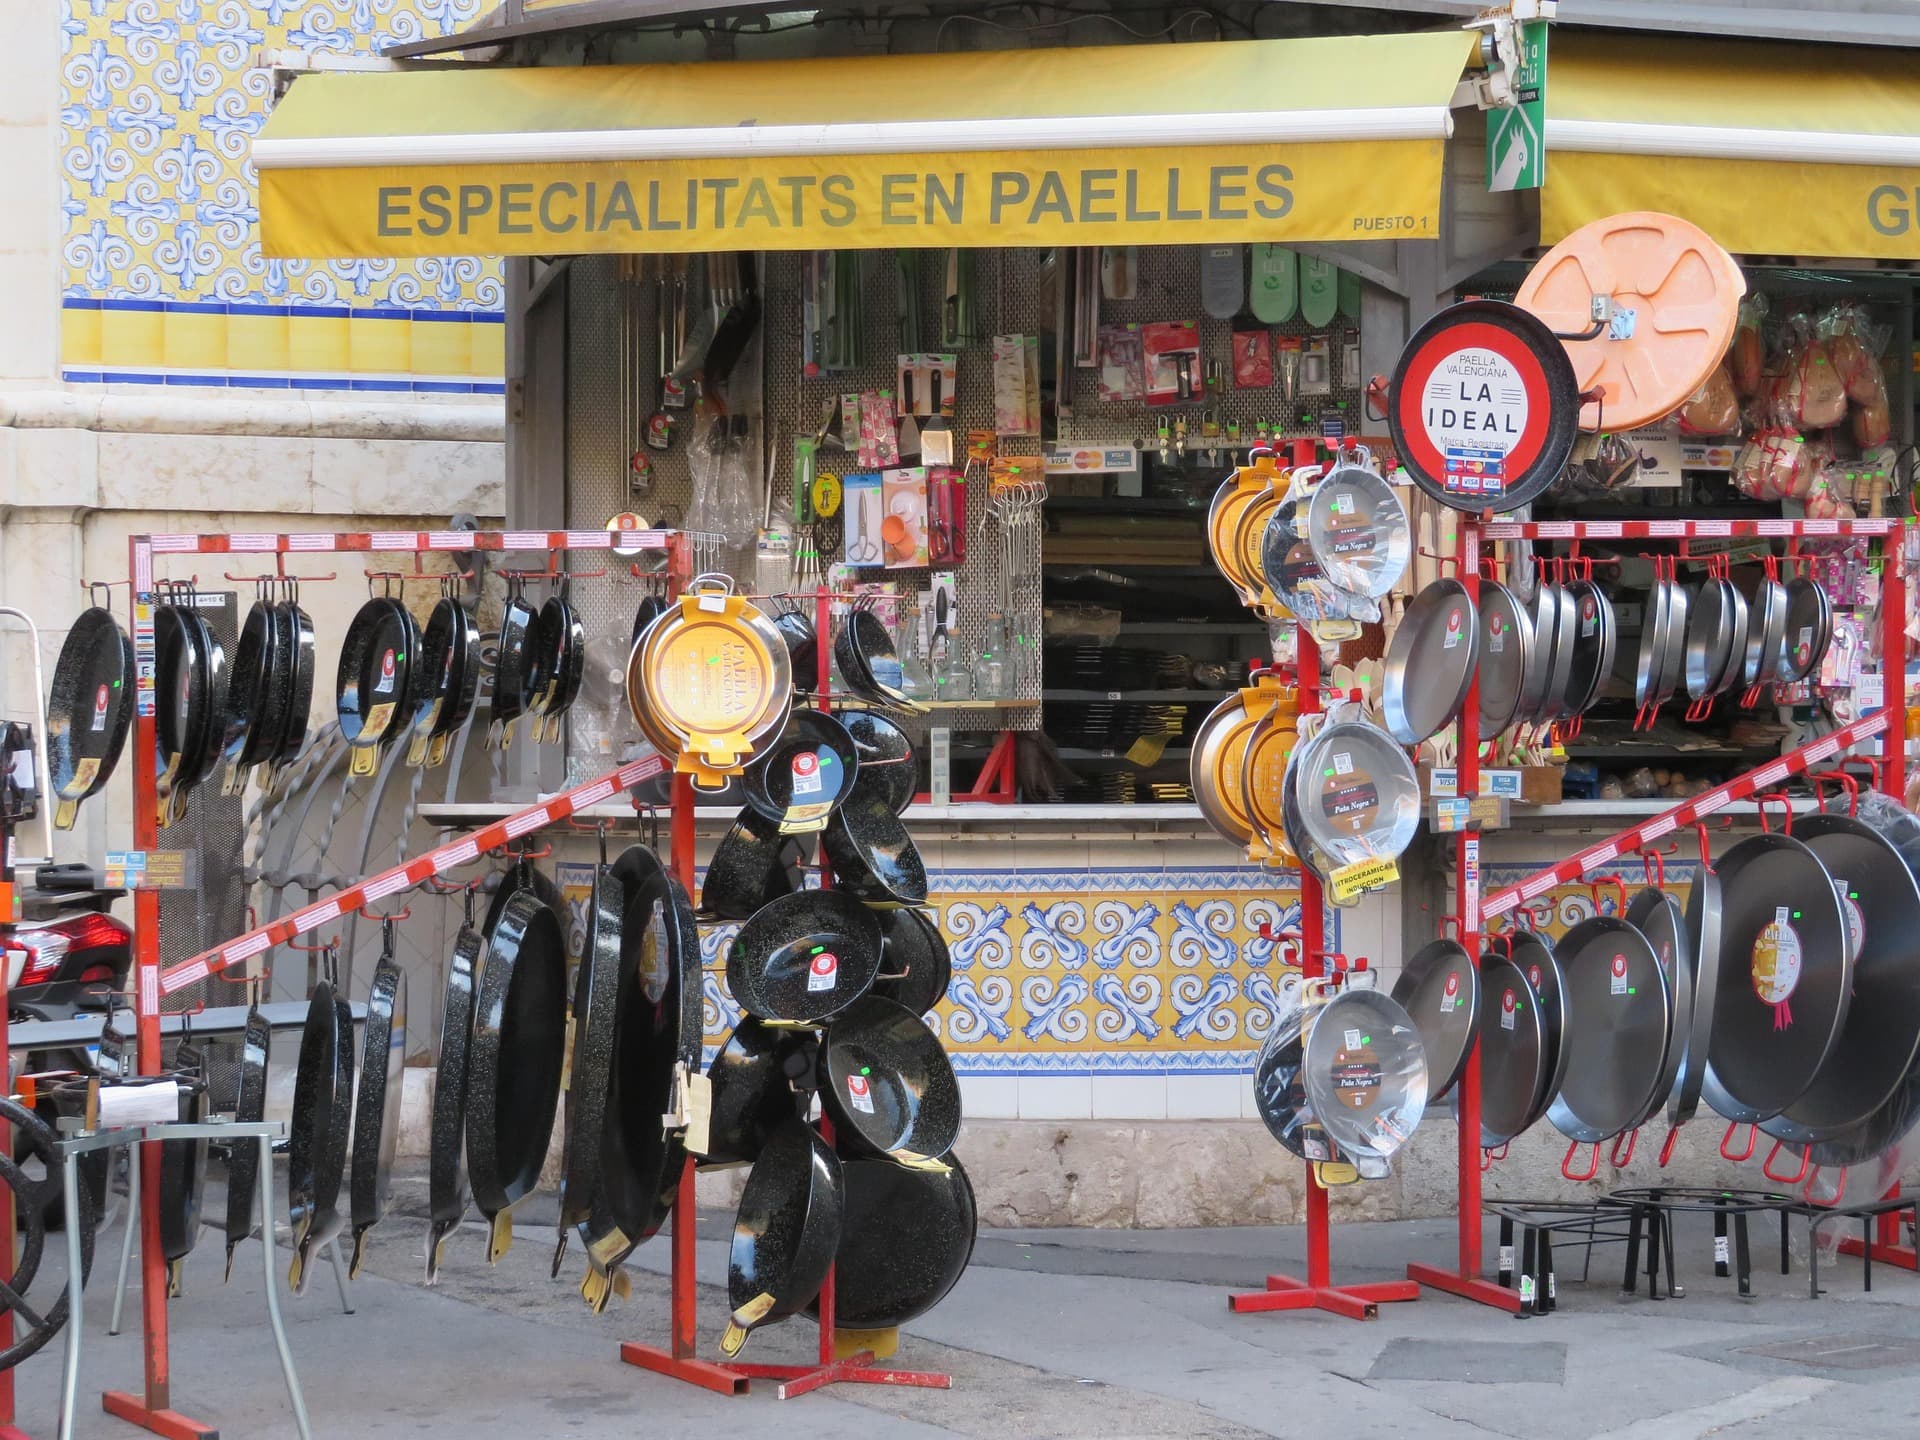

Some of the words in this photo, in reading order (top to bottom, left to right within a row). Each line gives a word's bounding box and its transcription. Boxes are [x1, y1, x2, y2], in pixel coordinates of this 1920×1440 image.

[377, 174, 856, 237] ESPECIALITATS
[881, 172, 965, 225] EN
[990, 163, 1295, 224] PAELLES
[1867, 184, 1920, 236] G
[1353, 216, 1415, 231] PUESTO
[1421, 216, 1428, 229] 1
[1459, 354, 1496, 366] PAELLA
[1447, 365, 1508, 378] VALENCIANA
[1459, 381, 1492, 403] LA
[1428, 407, 1518, 433] IDEAL
[1334, 804, 1350, 814] Pata
[1351, 800, 1369, 811] Negra
[1341, 1079, 1354, 1087] Pata
[1355, 1079, 1372, 1087] Negra
